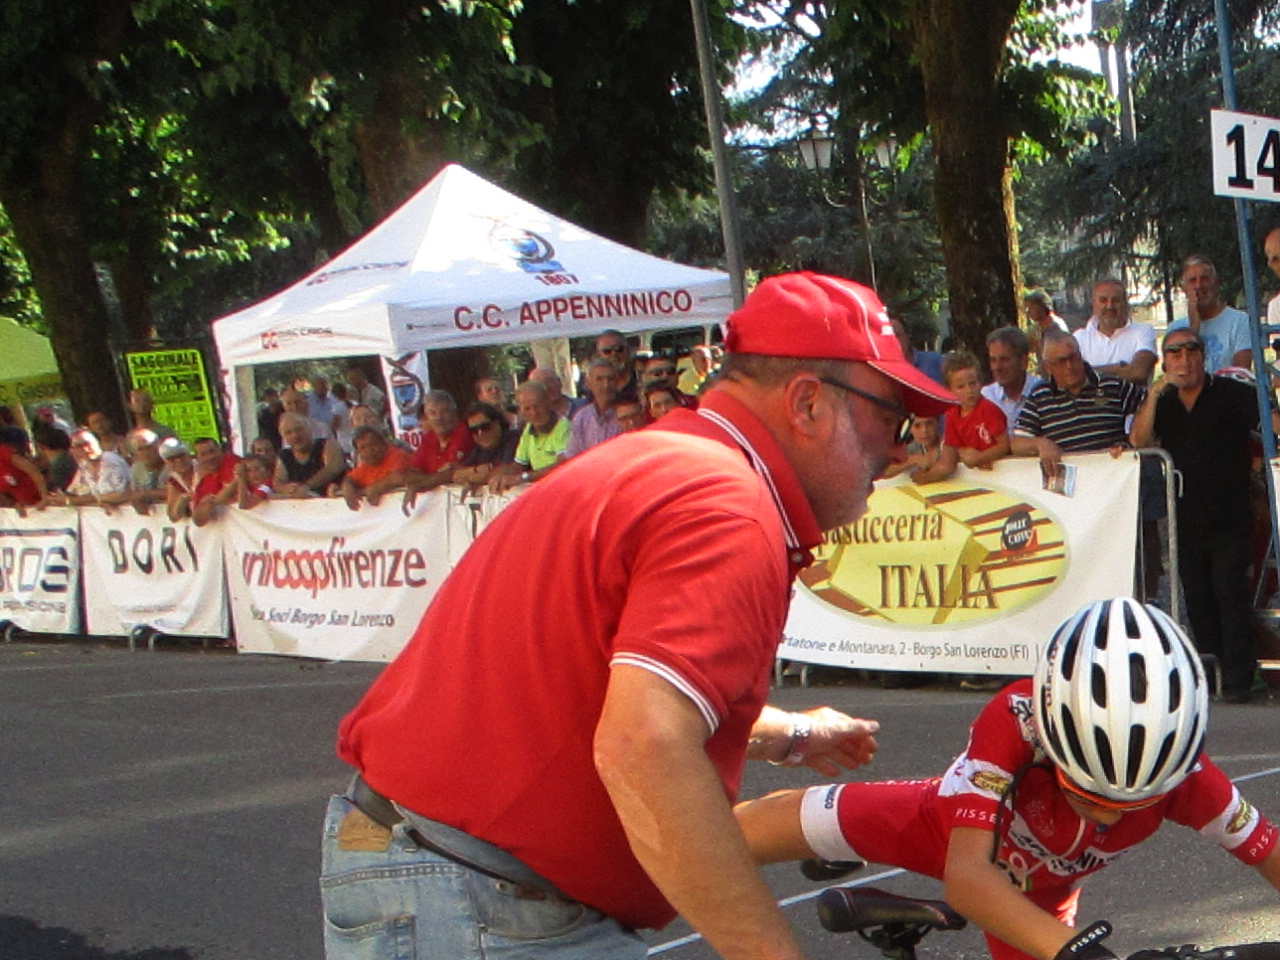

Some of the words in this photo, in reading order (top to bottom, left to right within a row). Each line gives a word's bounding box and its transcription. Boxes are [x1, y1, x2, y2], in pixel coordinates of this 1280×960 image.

[453, 304, 511, 331] C.C.
[519, 288, 693, 326] APPENNINICO
[877, 563, 999, 610] ITALIA
[290, 608, 326, 629] Borgo
[327, 609, 349, 626] San
[351, 609, 396, 628] Lorenzo
[899, 641, 906, 655] 2
[913, 641, 942, 660] Borgo
[943, 642, 962, 658] San
[963, 643, 1009, 660] Lorenzo
